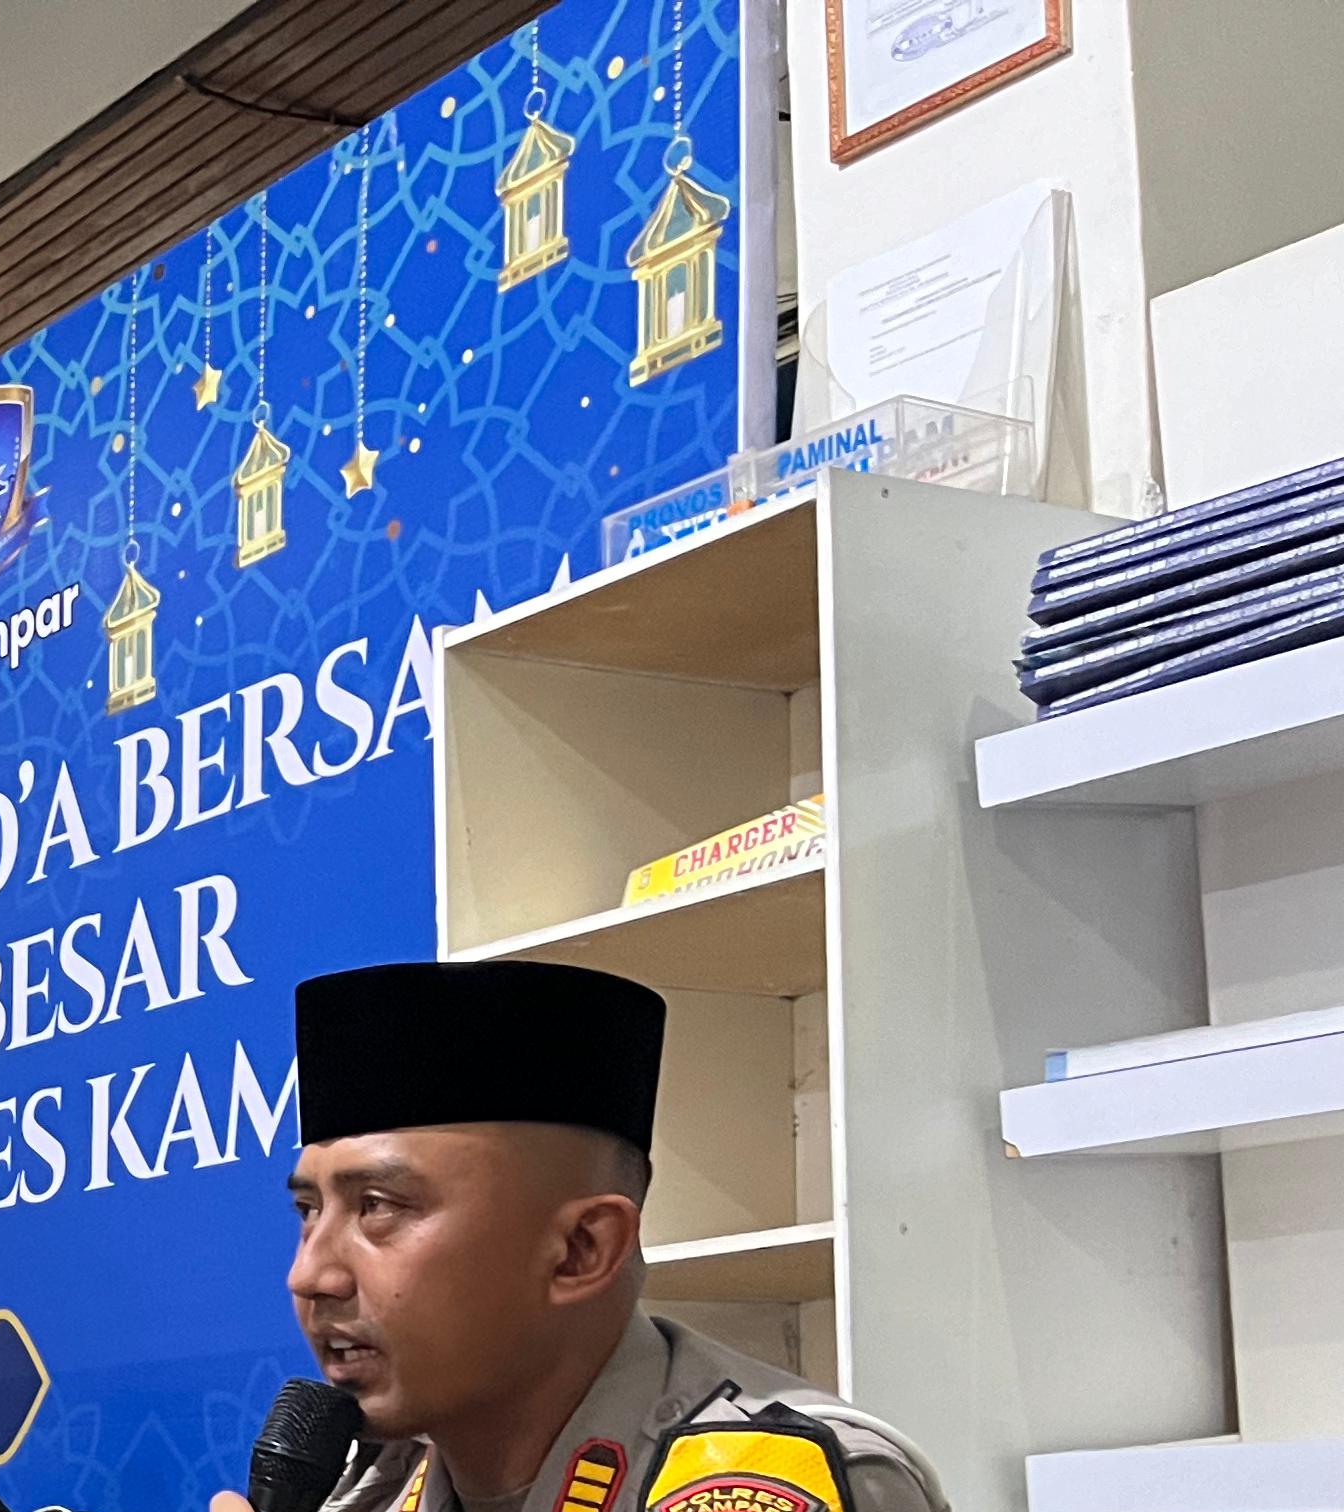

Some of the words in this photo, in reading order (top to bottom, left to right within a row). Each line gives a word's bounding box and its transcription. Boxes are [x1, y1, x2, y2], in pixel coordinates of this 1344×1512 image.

[778, 419, 883, 479] PAMINAL
[629, 483, 724, 533] PROVOS
[673, 812, 797, 878] CHARGER
